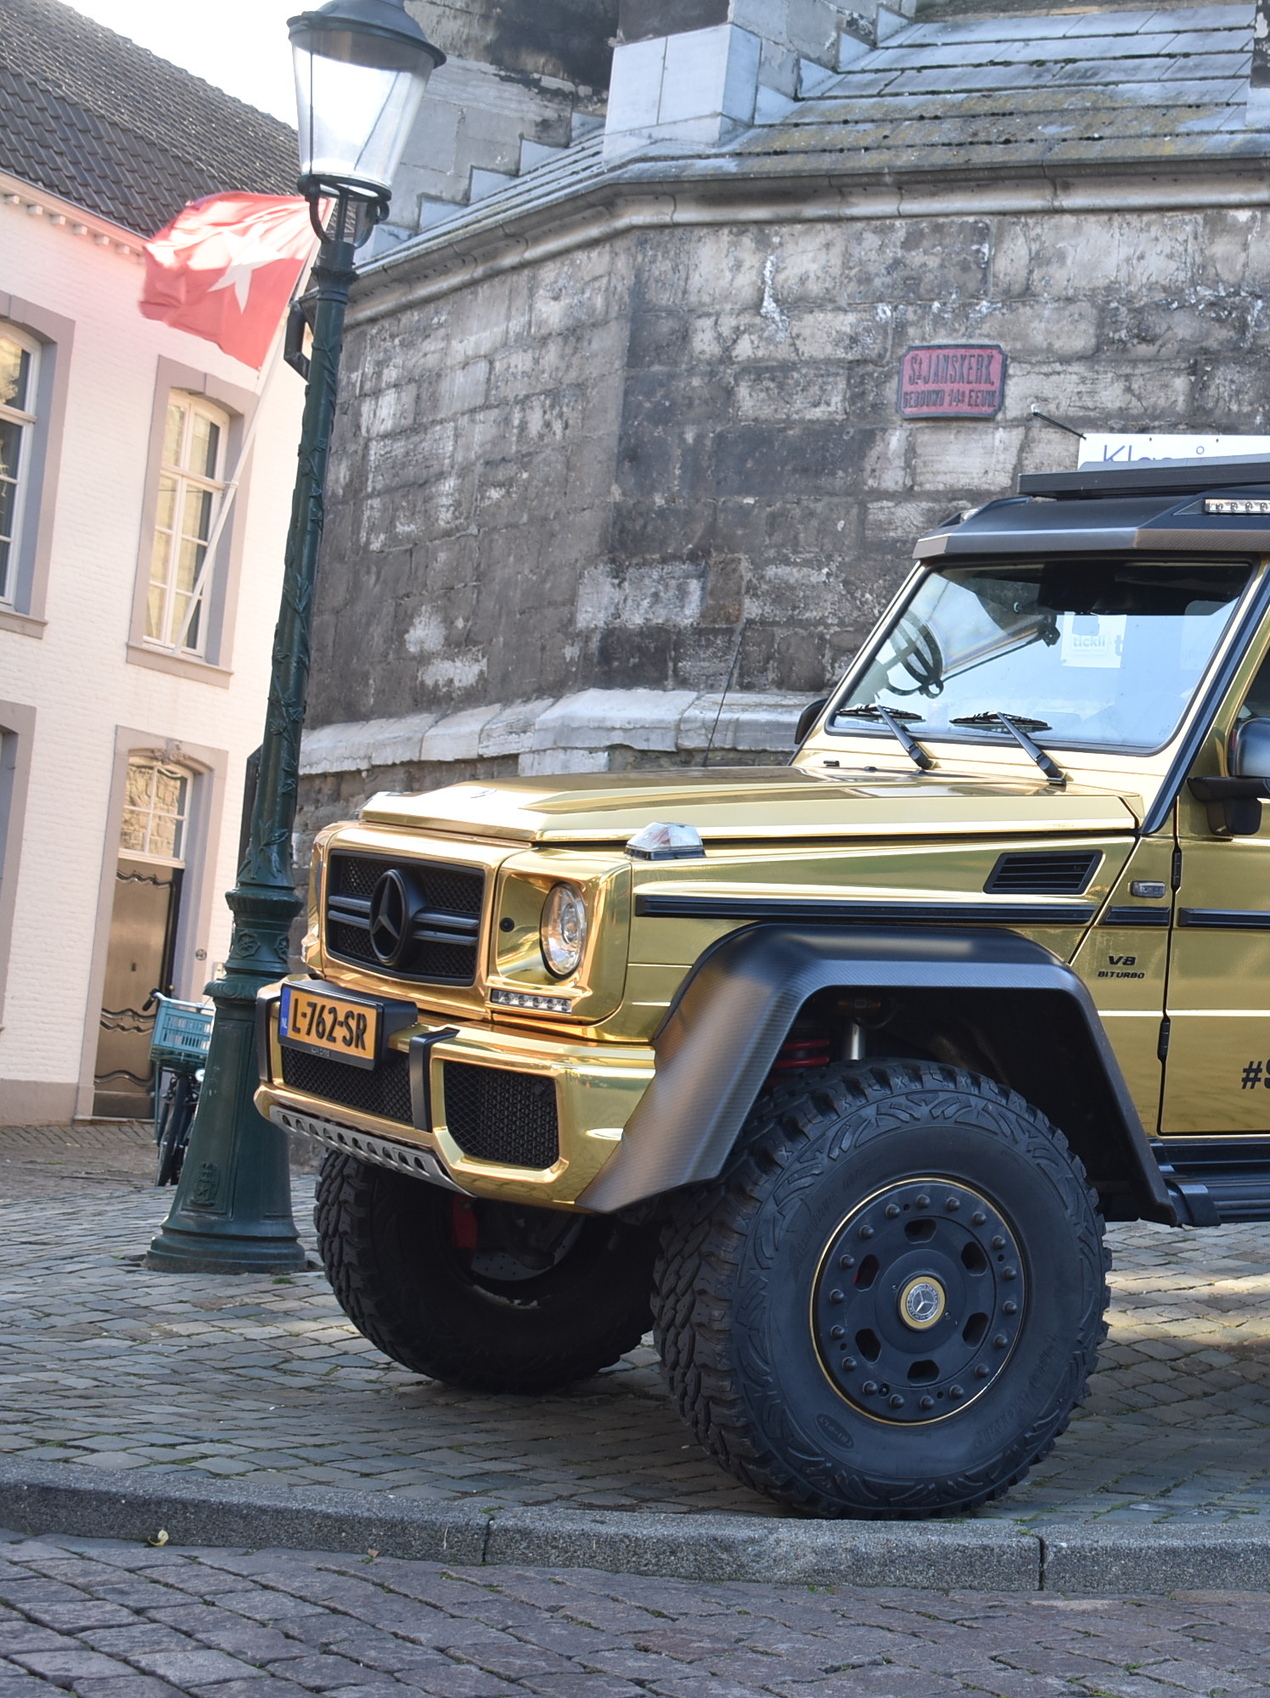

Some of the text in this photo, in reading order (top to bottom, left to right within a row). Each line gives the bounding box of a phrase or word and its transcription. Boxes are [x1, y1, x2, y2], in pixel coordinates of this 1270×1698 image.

[1108, 955, 1137, 966] V8
[1097, 970, 1145, 979] BITURBO
[291, 998, 367, 1051] L-762-SR
